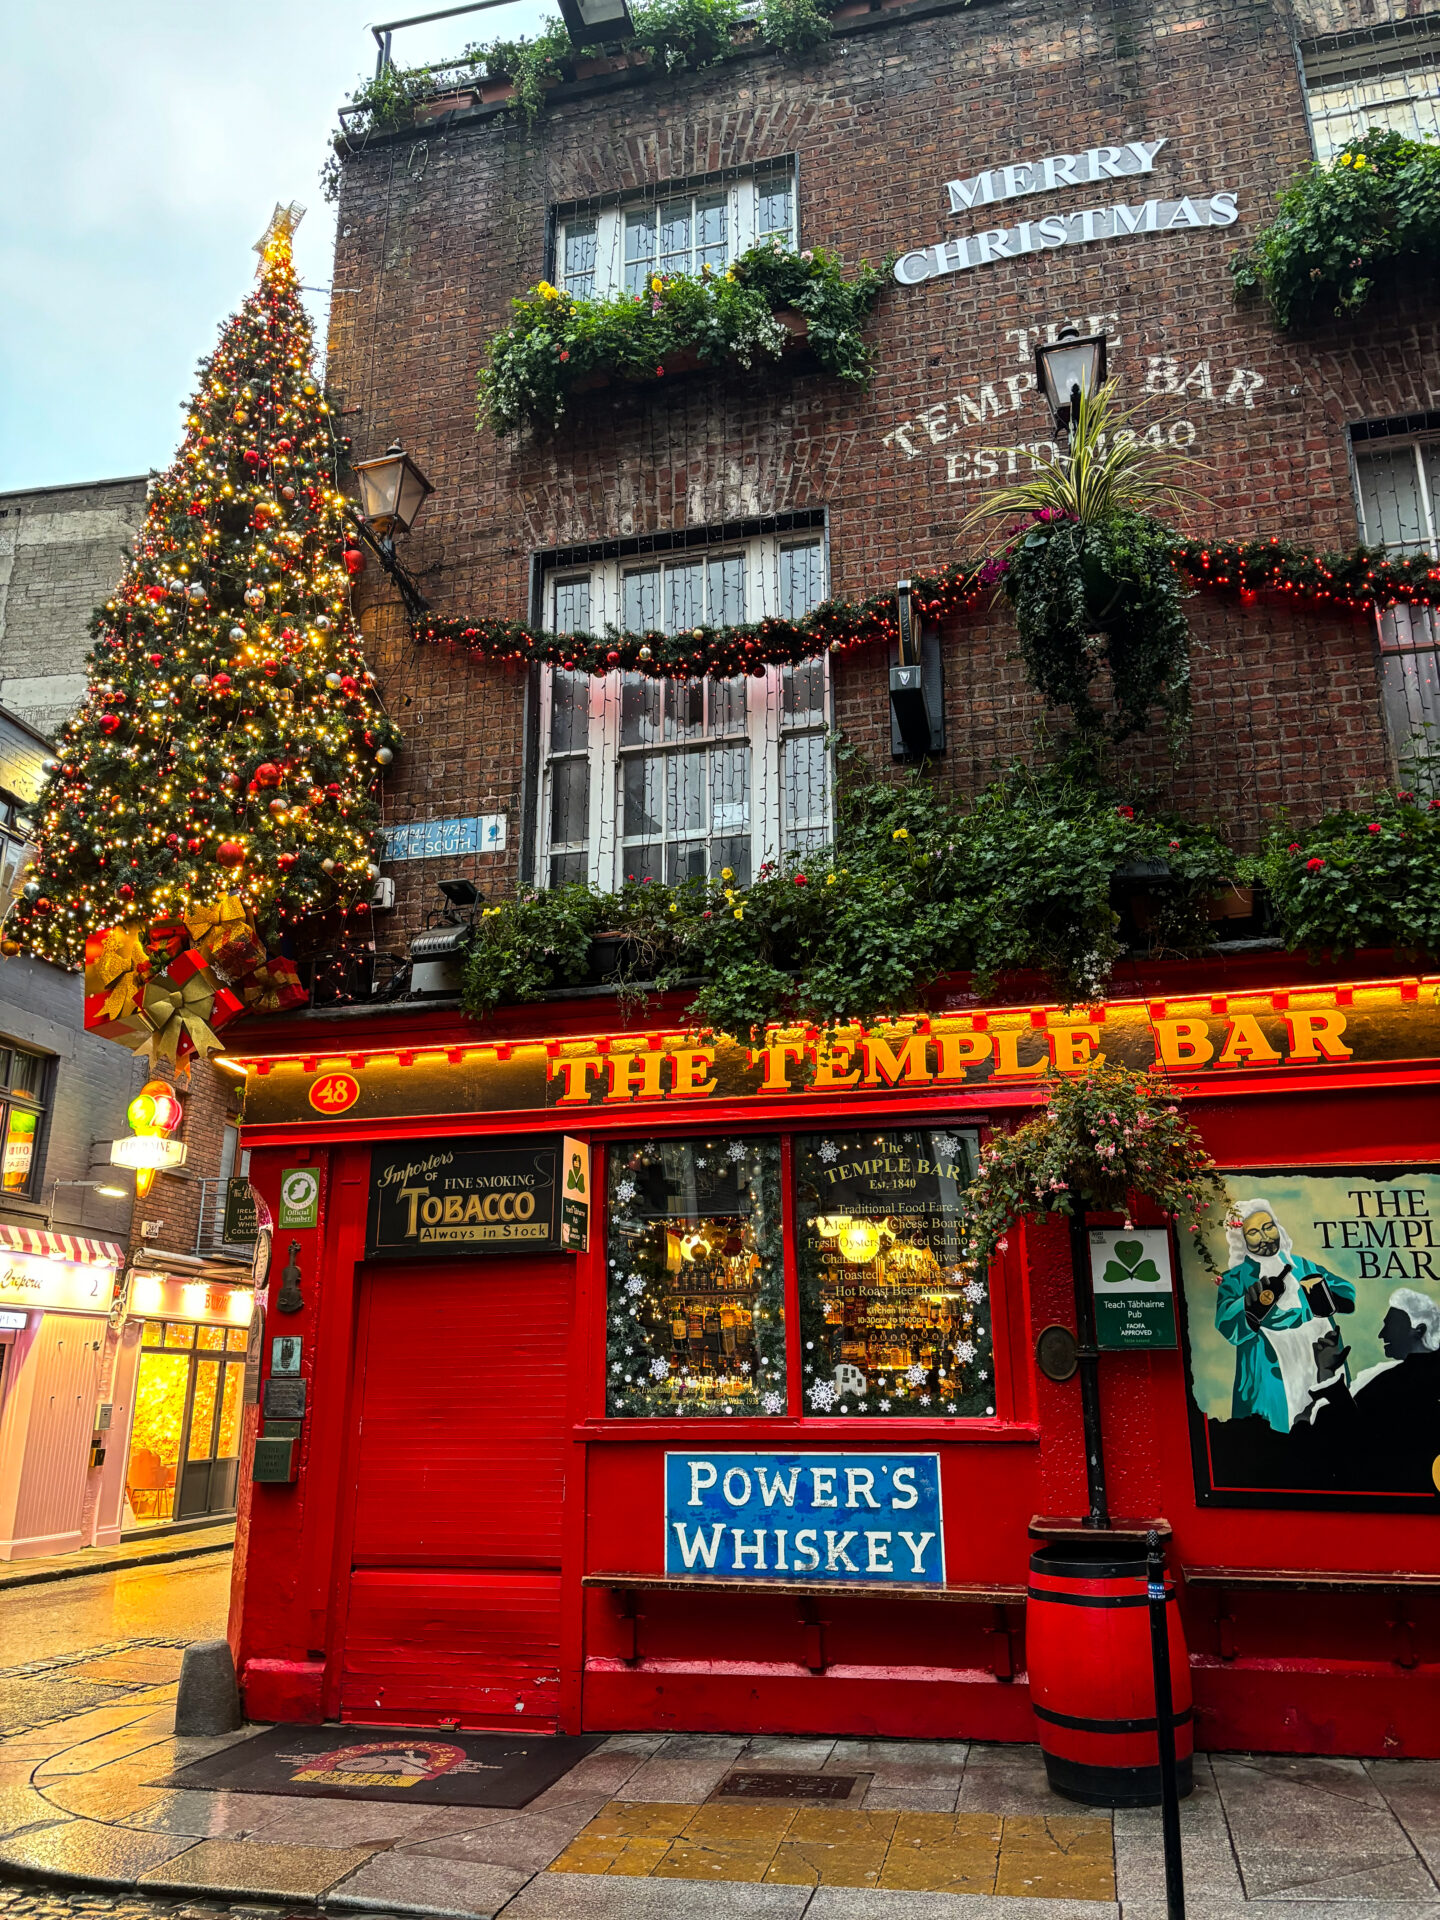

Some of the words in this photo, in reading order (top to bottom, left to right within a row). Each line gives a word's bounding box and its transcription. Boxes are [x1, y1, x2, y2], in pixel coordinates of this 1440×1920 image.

[942, 138, 1169, 214] MERRY
[893, 192, 1239, 284] CHRISTMAS
[1140, 356, 1265, 409] BAR
[425, 838, 471, 853] SOUTH
[548, 1047, 718, 1105] THE
[747, 1024, 1106, 1094] TEMPLE
[1149, 1009, 1353, 1073] BAR
[317, 1079, 348, 1104] 48
[879, 1142, 904, 1153] The
[377, 1151, 454, 1188] Importers
[823, 1157, 911, 1184] TEMPLE
[917, 1158, 960, 1181] BAR
[425, 1172, 438, 1181] OF
[444, 1177, 473, 1190] FINE
[475, 1174, 536, 1188] SMOKING
[893, 1178, 917, 1189] 1840
[396, 1185, 536, 1238] TOBACCO
[837, 1202, 895, 1215] Traditional
[898, 1202, 926, 1214] Food
[1348, 1189, 1430, 1218] THE
[422, 1228, 475, 1240] Always
[483, 1227, 496, 1238] in
[502, 1224, 546, 1237] Stock
[890, 1218, 929, 1229] Cheese
[808, 1237, 836, 1249] Fresh
[886, 1235, 930, 1247] Smoked
[933, 1234, 968, 1246] Salmo
[1313, 1219, 1440, 1249] TEMPL
[837, 1269, 878, 1280] Toasted
[1356, 1250, 1440, 1281] BAR
[90, 1279, 98, 1297] 2
[835, 1285, 857, 1297] Hot
[858, 1286, 889, 1296] Roast
[892, 1285, 918, 1296] Beef
[921, 1284, 950, 1295] Rolls
[1103, 1300, 1126, 1309] Teach
[889, 1316, 898, 1324] to
[1128, 1310, 1142, 1319] Pub
[687, 1461, 919, 1510] POWER'S
[672, 1522, 936, 1574] WHISKEY
